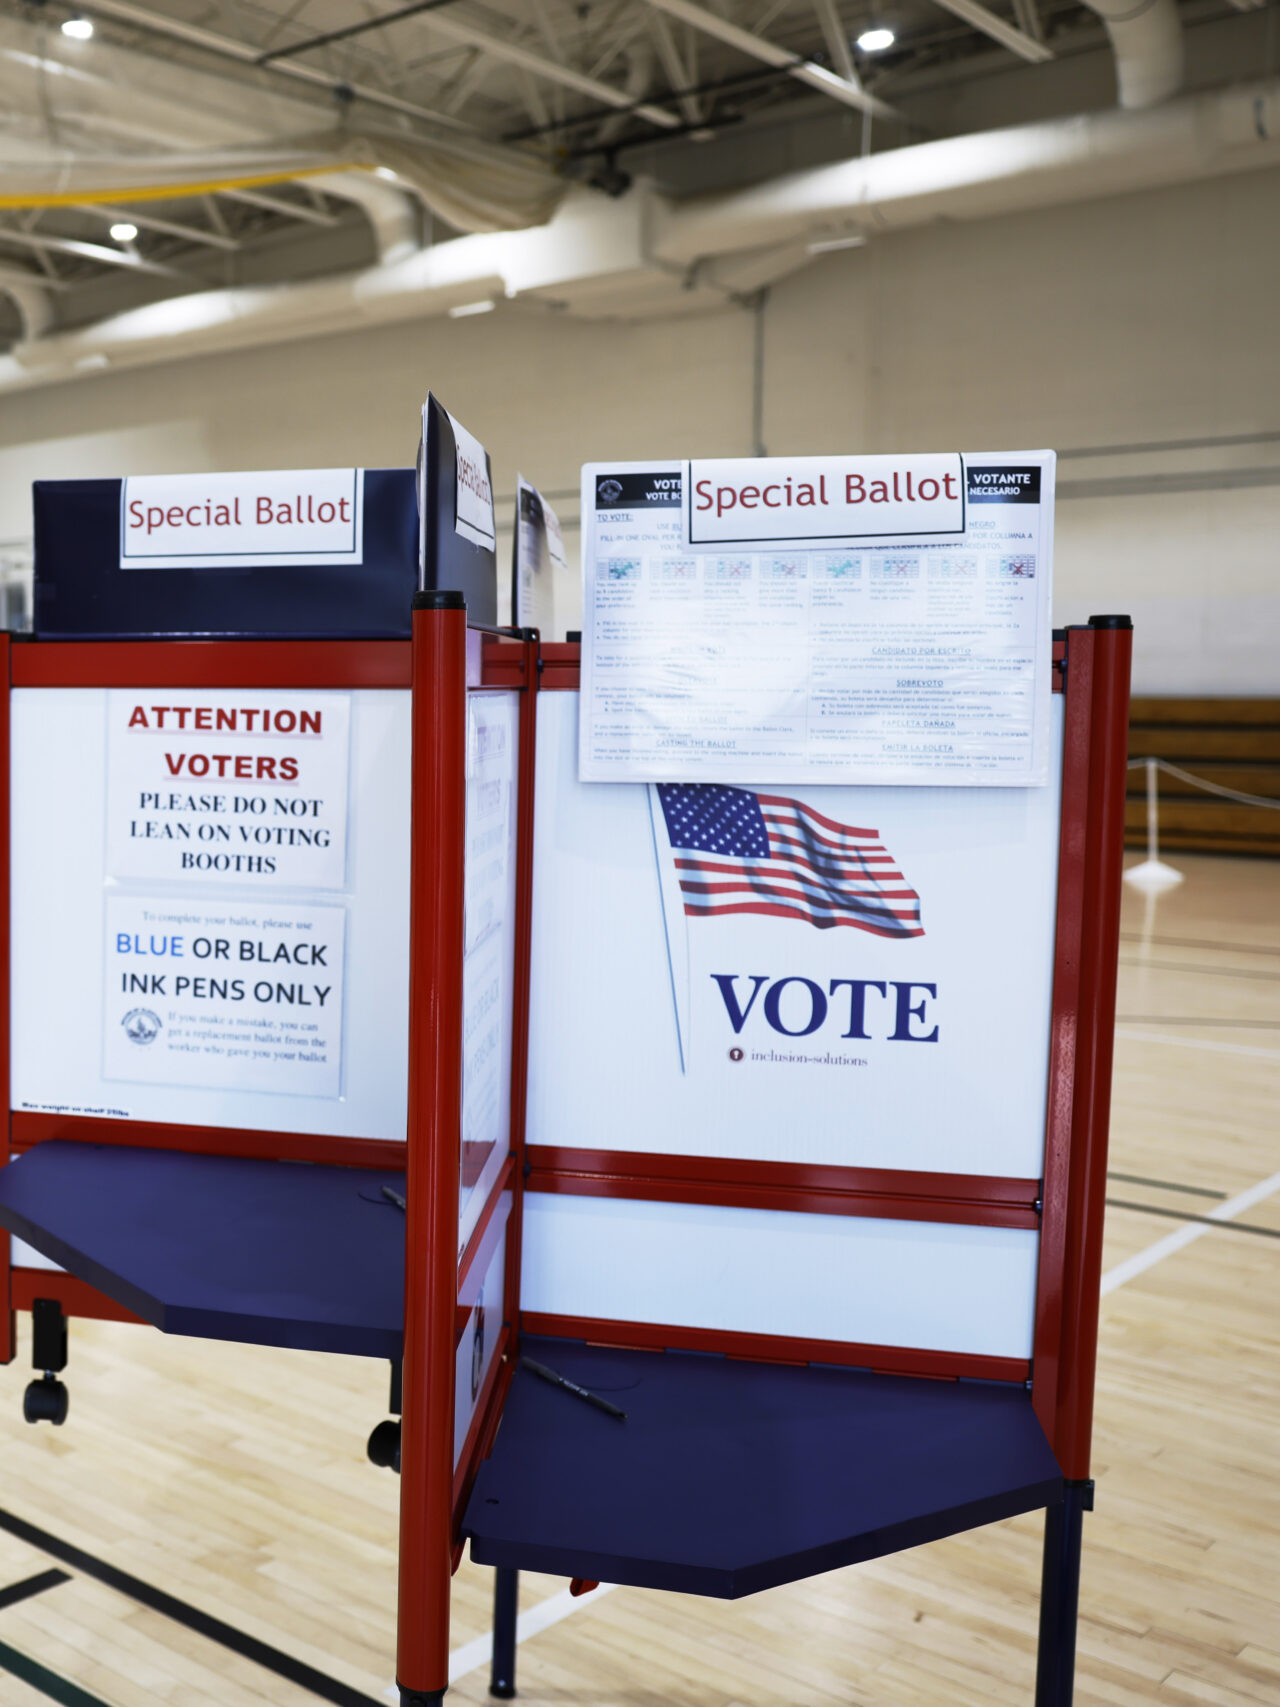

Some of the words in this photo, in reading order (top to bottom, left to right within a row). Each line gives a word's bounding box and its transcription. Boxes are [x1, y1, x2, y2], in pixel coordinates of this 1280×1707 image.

[973, 473, 1031, 484] VOTANTE
[645, 491, 669, 500] VOTE
[695, 474, 829, 518] Special
[845, 471, 959, 504] Ballot
[969, 486, 1021, 495] NECESARIO
[128, 496, 242, 535] Special
[255, 494, 351, 525] Ballot
[896, 679, 944, 688] SOBREVOTO
[128, 705, 323, 735] ATTENTION
[923, 719, 956, 728] DAÑADA
[690, 740, 705, 748] THE
[707, 740, 737, 748] BALLOT
[922, 744, 954, 752] BOLETA
[164, 752, 300, 782] VOTERS
[139, 791, 227, 814] PLEASE
[233, 796, 267, 816] DO
[273, 797, 324, 818] NOT
[129, 820, 191, 841] LEAN
[198, 823, 231, 843] ON
[238, 825, 331, 849] VOTING
[181, 851, 277, 875] BOOTHS
[143, 911, 160, 923] To
[162, 912, 202, 927] complete
[204, 916, 228, 929] your
[262, 917, 294, 932] please
[296, 920, 313, 931] use
[116, 932, 185, 958] BLUE
[192, 937, 230, 960] OR
[239, 940, 328, 966] BLACK
[121, 972, 167, 996] INK
[176, 975, 246, 1001] PENS
[253, 981, 332, 1007] ONLY
[709, 973, 941, 1044] VOTE
[168, 1011, 177, 1022] If
[178, 1013, 197, 1025] you
[199, 1013, 225, 1025] make
[228, 1017, 234, 1025] a
[279, 1021, 299, 1033] you
[300, 1022, 319, 1032] can
[185, 1029, 191, 1037] a
[192, 1027, 252, 1043] replacement
[253, 1031, 282, 1044] ballot
[284, 1035, 311, 1047] from
[313, 1037, 327, 1049] the
[168, 1042, 200, 1055] worker
[203, 1043, 224, 1056] who
[227, 1047, 251, 1059] gave
[252, 1049, 271, 1061] you
[272, 1051, 297, 1063] your
[298, 1051, 328, 1064] ballot
[750, 1048, 869, 1068] inclusion-solutions
